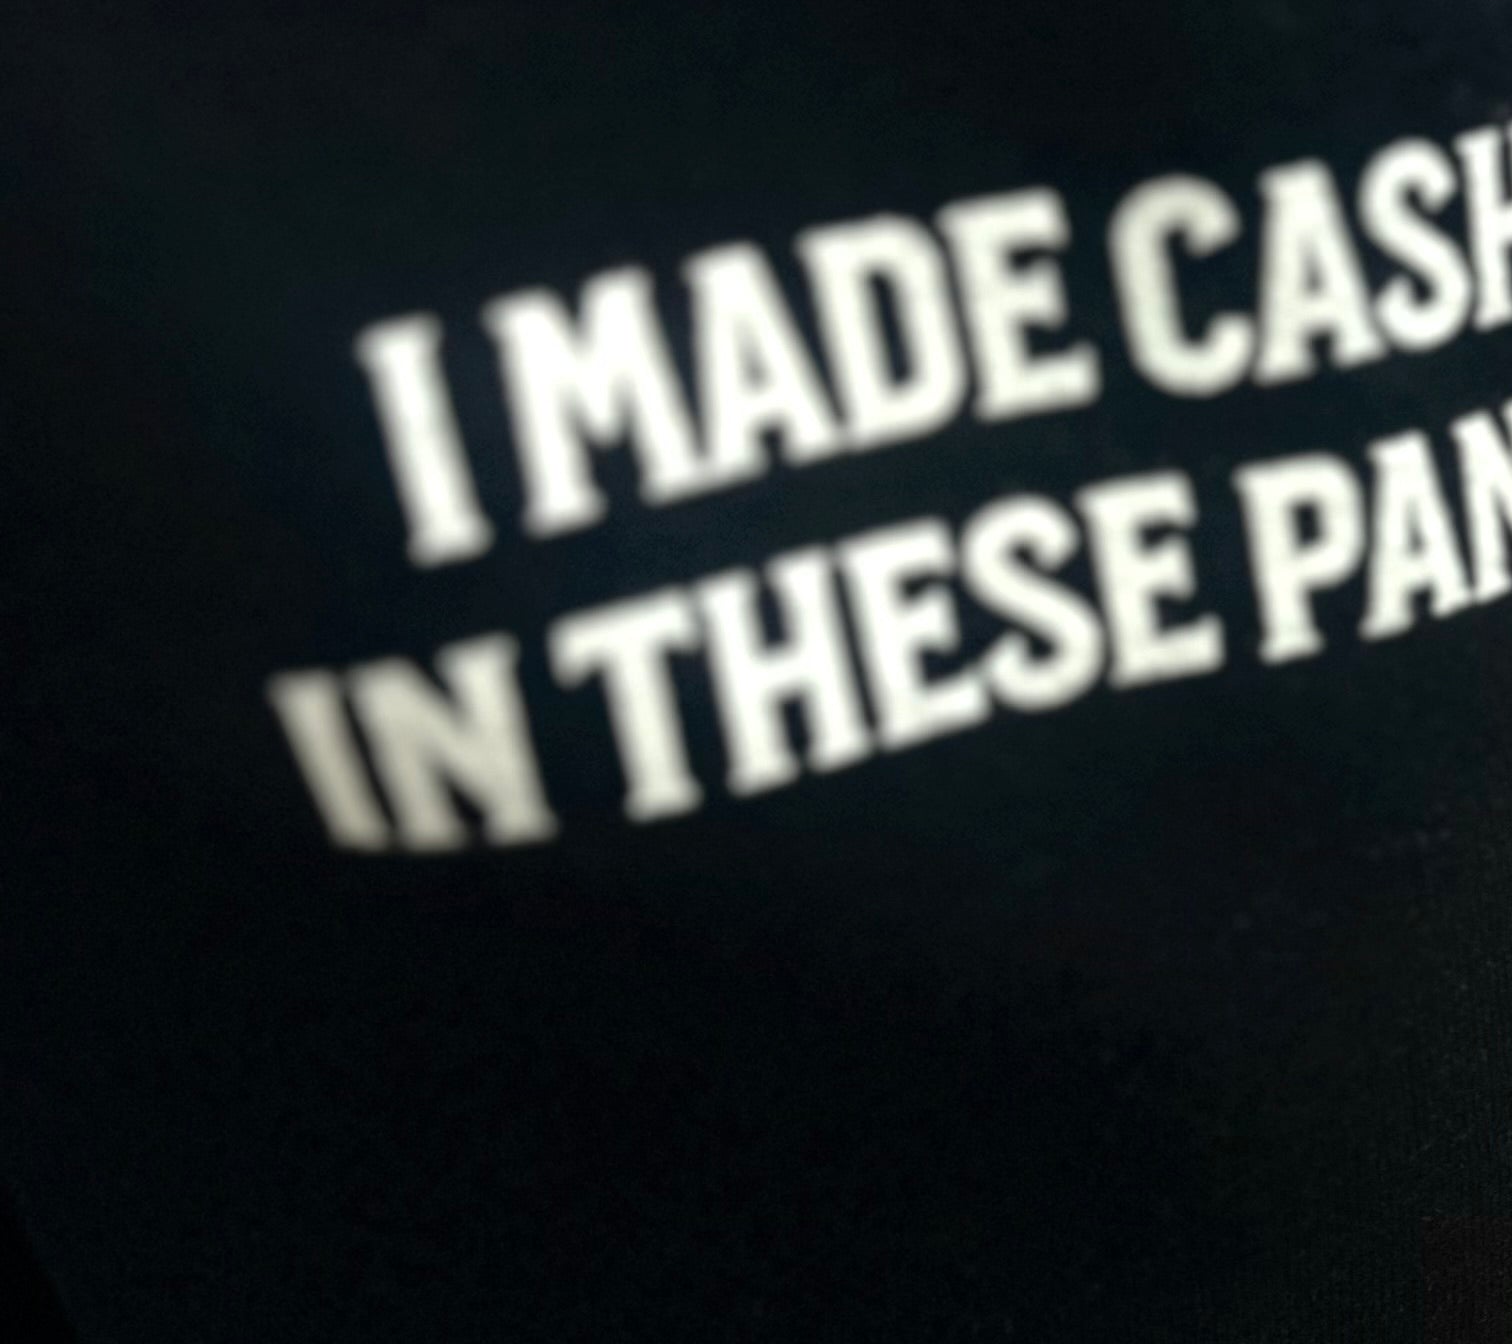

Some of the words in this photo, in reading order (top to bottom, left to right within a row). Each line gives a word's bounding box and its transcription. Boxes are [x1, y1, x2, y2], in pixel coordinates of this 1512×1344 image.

[356, 312, 492, 568] I
[482, 186, 1102, 538] MADE
[268, 632, 556, 852] IN
[548, 468, 1226, 822] THESE
